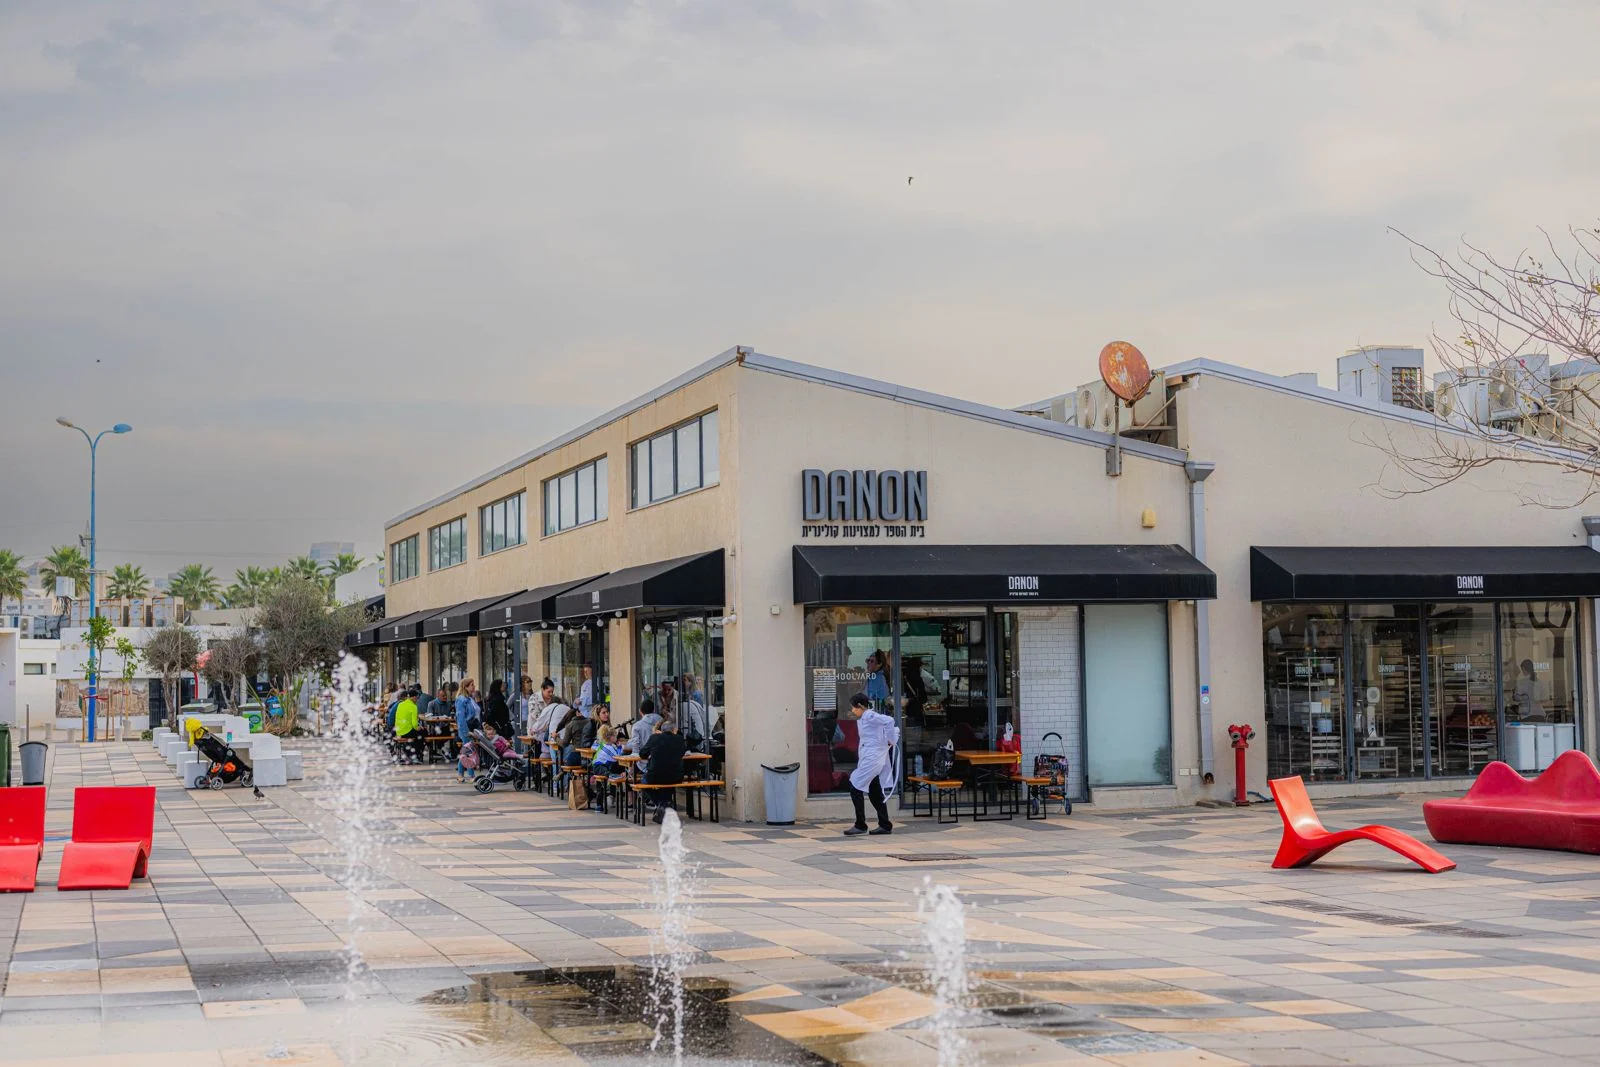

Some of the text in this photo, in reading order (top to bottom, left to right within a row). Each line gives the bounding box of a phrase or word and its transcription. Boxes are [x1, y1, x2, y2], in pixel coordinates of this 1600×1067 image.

[802, 469, 928, 521] DANON
[802, 524, 925, 538] בית הספר למצוינות קולינרית
[1008, 576, 1039, 590] DANON
[1456, 576, 1484, 589] DANON
[829, 672, 877, 681] HOOLYARD
